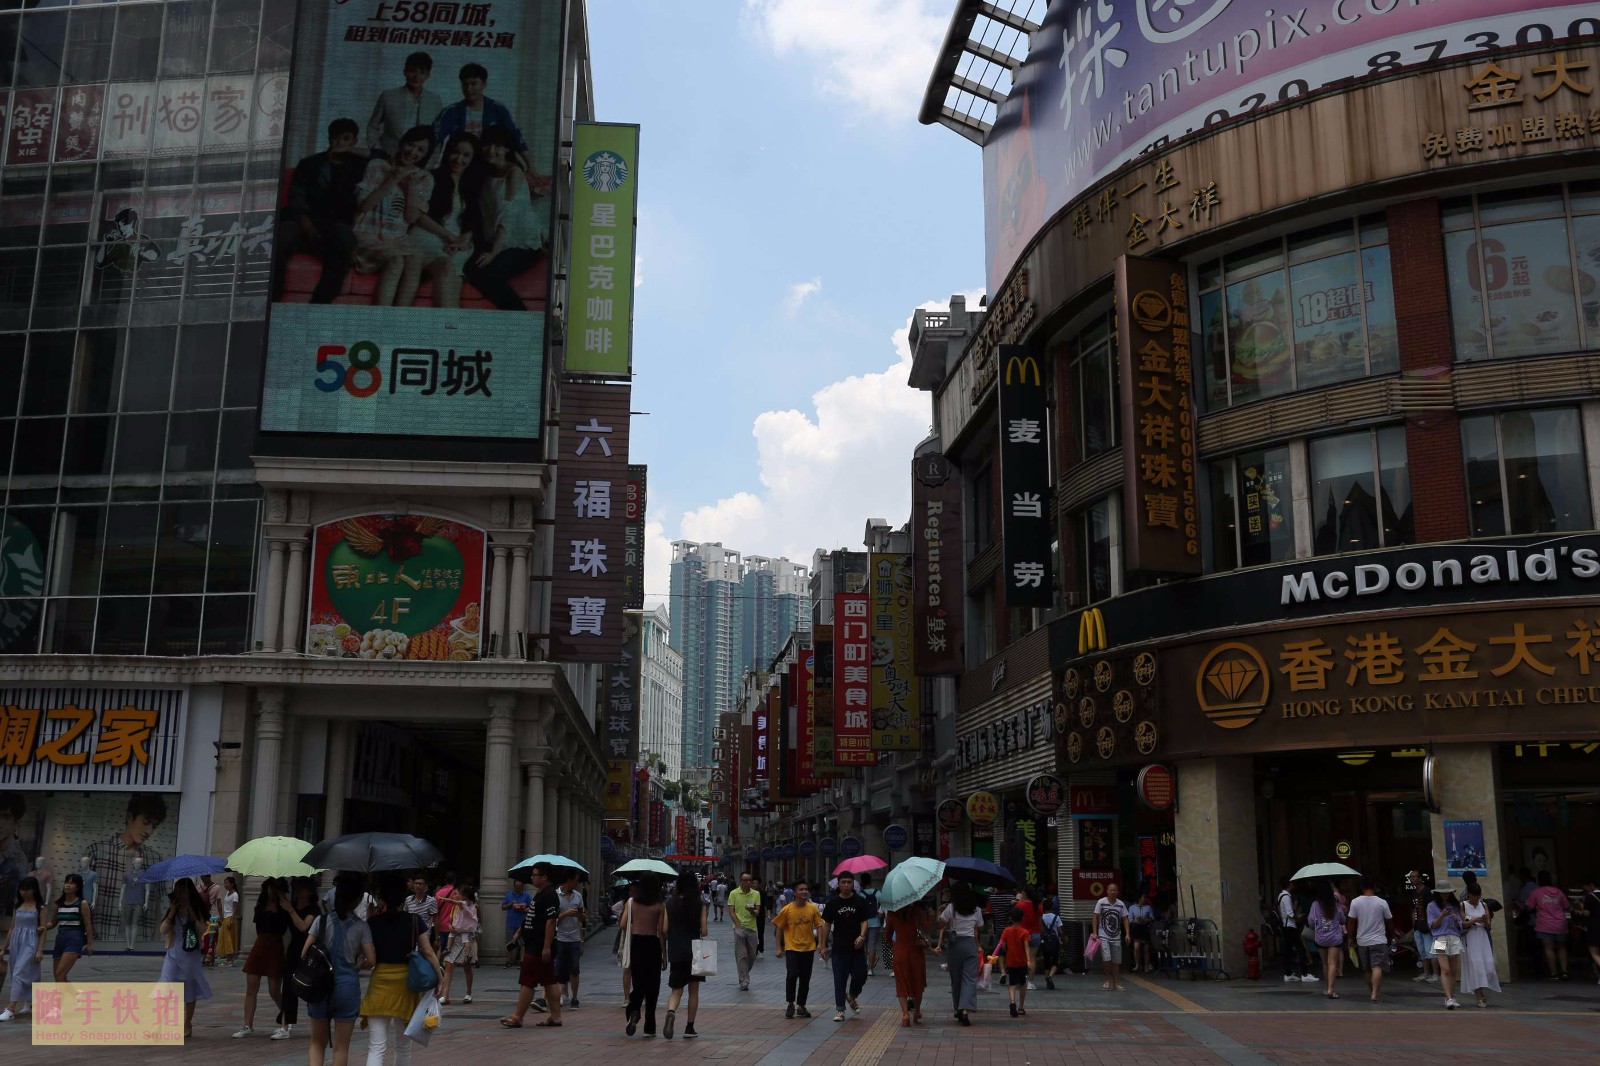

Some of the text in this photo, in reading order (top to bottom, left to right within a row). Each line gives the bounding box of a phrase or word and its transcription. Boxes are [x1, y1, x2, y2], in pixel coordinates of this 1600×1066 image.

[344, 25, 516, 50] 租到你的爱情公寓
[17, 147, 39, 158] XIE
[1073, 160, 1179, 239] 祥伴一生
[1127, 179, 1223, 250] 金大祥
[583, 202, 616, 356] 星巴克咖啡
[1511, 255, 1531, 287] 元起
[314, 340, 493, 398] 58同城
[1138, 338, 1181, 531] 金大祥珠寶
[567, 417, 614, 639] 六福珠寶
[1007, 417, 1045, 588] 麦当劳
[1280, 545, 1600, 606] McDonald's
[370, 597, 412, 624] 4F
[926, 615, 947, 653] 皇茶
[843, 599, 869, 729] 西门町美食城
[1281, 698, 1342, 720] HONG
[1350, 694, 1415, 715] KONG
[1424, 689, 1481, 710] KAM
[1484, 688, 1526, 707] TAI
